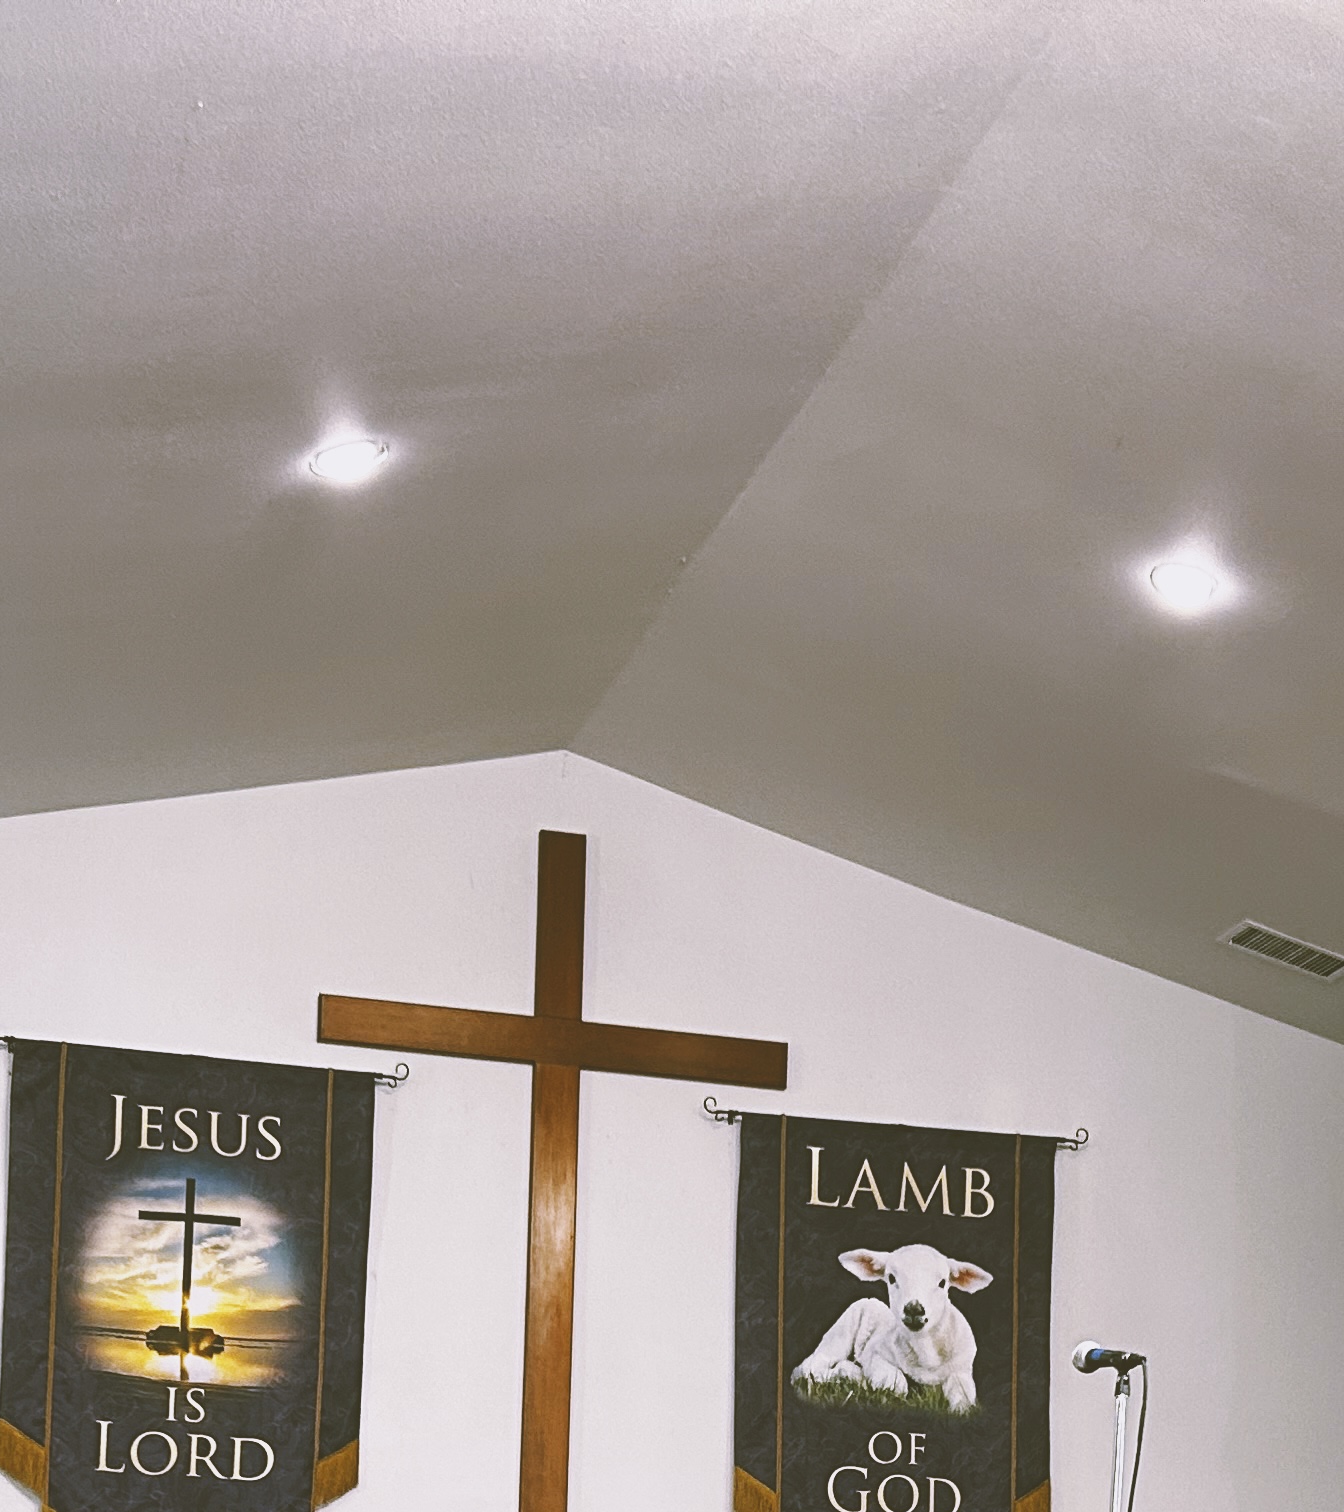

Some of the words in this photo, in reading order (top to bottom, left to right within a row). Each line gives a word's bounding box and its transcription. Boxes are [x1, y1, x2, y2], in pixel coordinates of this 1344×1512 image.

[105, 1094, 283, 1161] JESUS
[806, 1146, 995, 1219] LAMB
[166, 1387, 206, 1423] IS
[95, 1420, 275, 1481] LORD
[868, 1430, 926, 1466] OF
